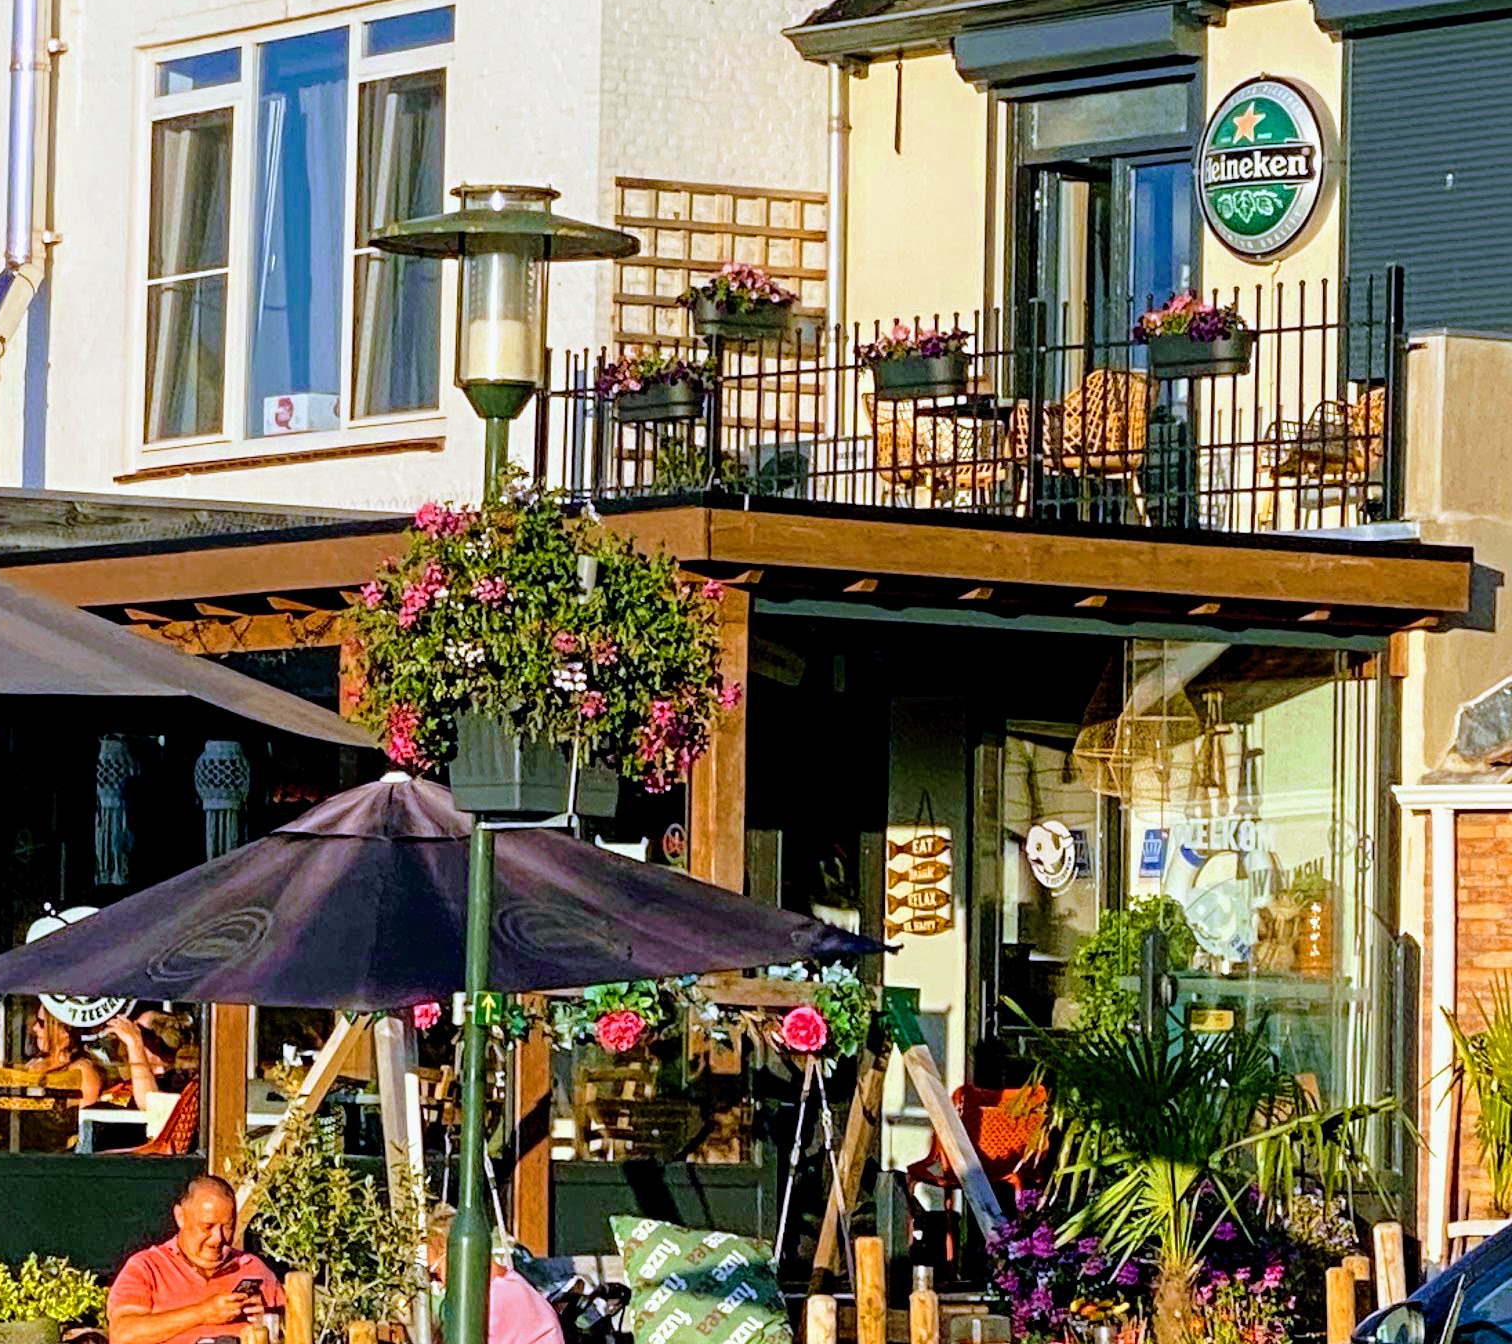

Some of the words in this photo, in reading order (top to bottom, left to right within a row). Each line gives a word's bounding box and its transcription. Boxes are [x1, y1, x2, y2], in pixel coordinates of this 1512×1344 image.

[1204, 150, 1308, 184] Heineken
[911, 838, 934, 854] EAT
[907, 891, 937, 907] RELAX
[639, 1238, 682, 1279] fuze
[711, 1249, 750, 1282] fuze
[644, 1272, 688, 1313] fuze
[717, 1281, 758, 1314] fuze
